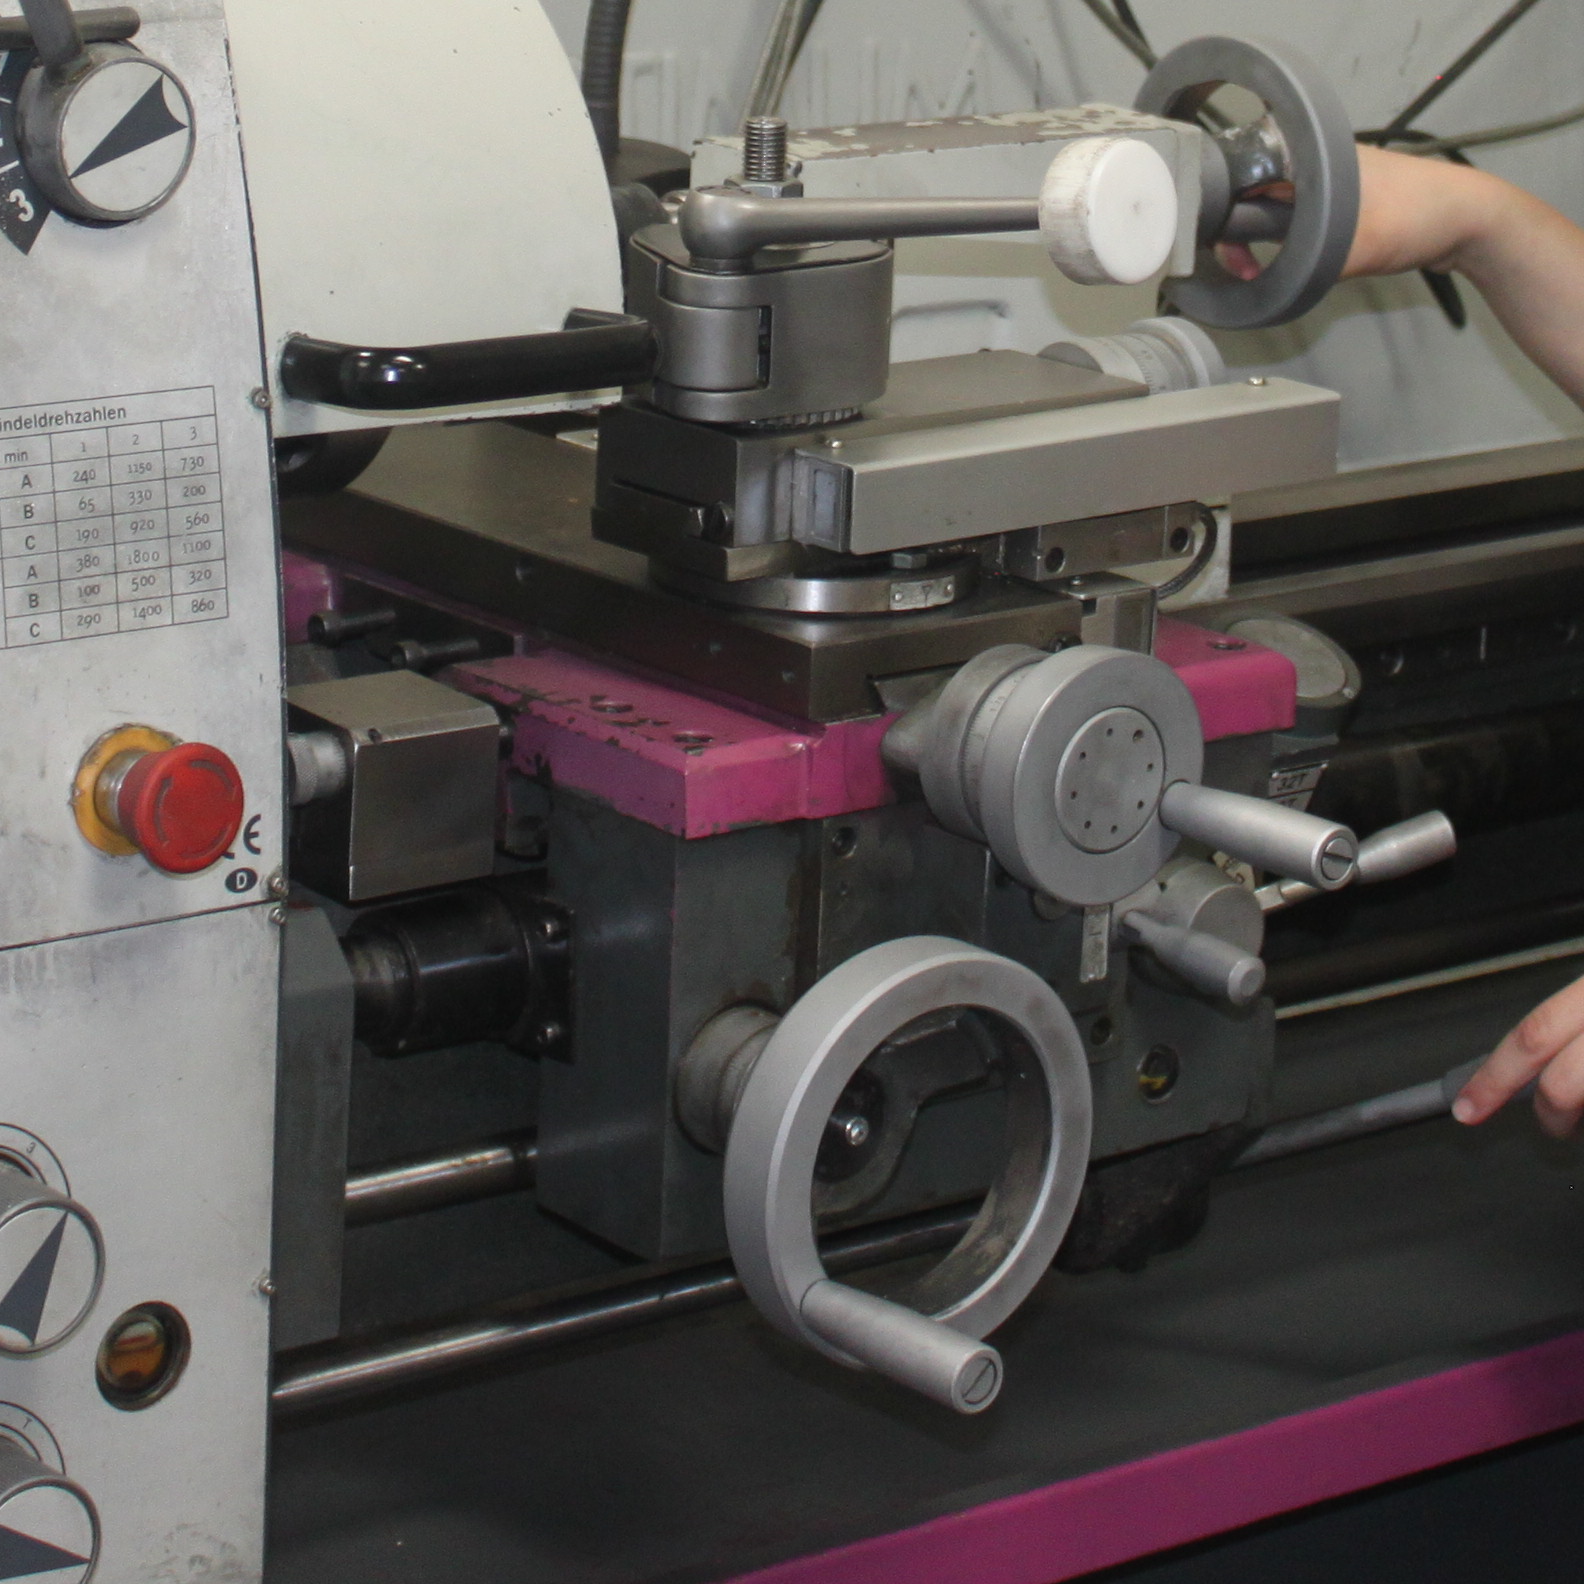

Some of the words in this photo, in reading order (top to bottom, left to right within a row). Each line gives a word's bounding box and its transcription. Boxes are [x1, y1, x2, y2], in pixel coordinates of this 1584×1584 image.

[9, 188, 34, 222] 3
[82, 442, 86, 452] 1
[132, 435, 139, 445] 2
[190, 426, 197, 440] 3
[21, 474, 32, 489] A
[73, 469, 96, 483] 240
[181, 456, 204, 471] 730
[24, 504, 34, 519] B
[79, 497, 95, 512] 65
[129, 490, 152, 505] 330
[183, 485, 206, 497] 200
[25, 535, 36, 550] C
[77, 528, 99, 543] 190
[130, 519, 155, 533] 920
[185, 513, 209, 530] 560
[27, 565, 37, 580] A
[76, 555, 100, 572] 380
[128, 550, 160, 565] 1800
[29, 594, 39, 608] B
[78, 584, 100, 597] 100
[132, 576, 156, 591] 500
[189, 569, 212, 585] 320
[30, 623, 40, 638] C
[77, 615, 101, 628] 290
[133, 605, 162, 620] 1400
[191, 599, 214, 613] 860
[26, 1142, 36, 1154] 3
[22, 1417, 33, 1429] T
